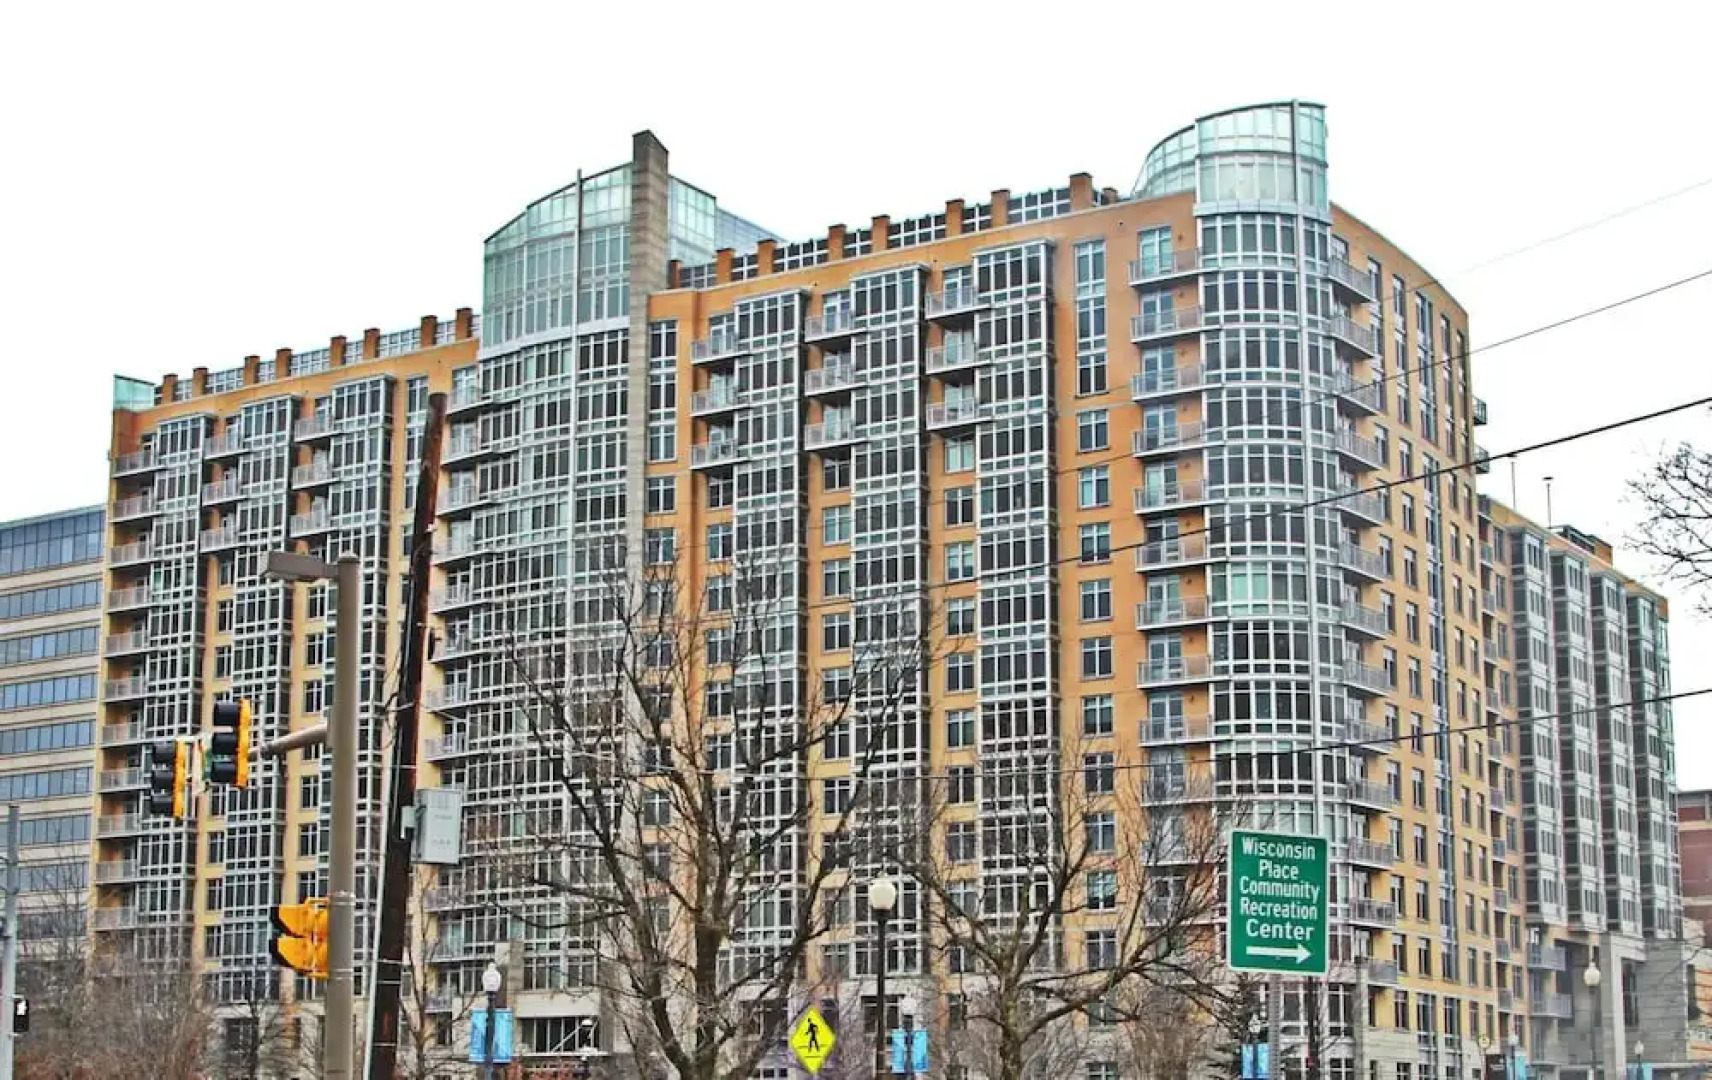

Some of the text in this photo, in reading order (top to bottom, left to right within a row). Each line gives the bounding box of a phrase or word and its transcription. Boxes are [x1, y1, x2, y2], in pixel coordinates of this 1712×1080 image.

[1242, 836, 1316, 860] Wisconsin
[1259, 859, 1299, 880] Place
[1239, 876, 1320, 904] Community
[1240, 897, 1318, 920] Recreation
[1246, 918, 1315, 941] Center
